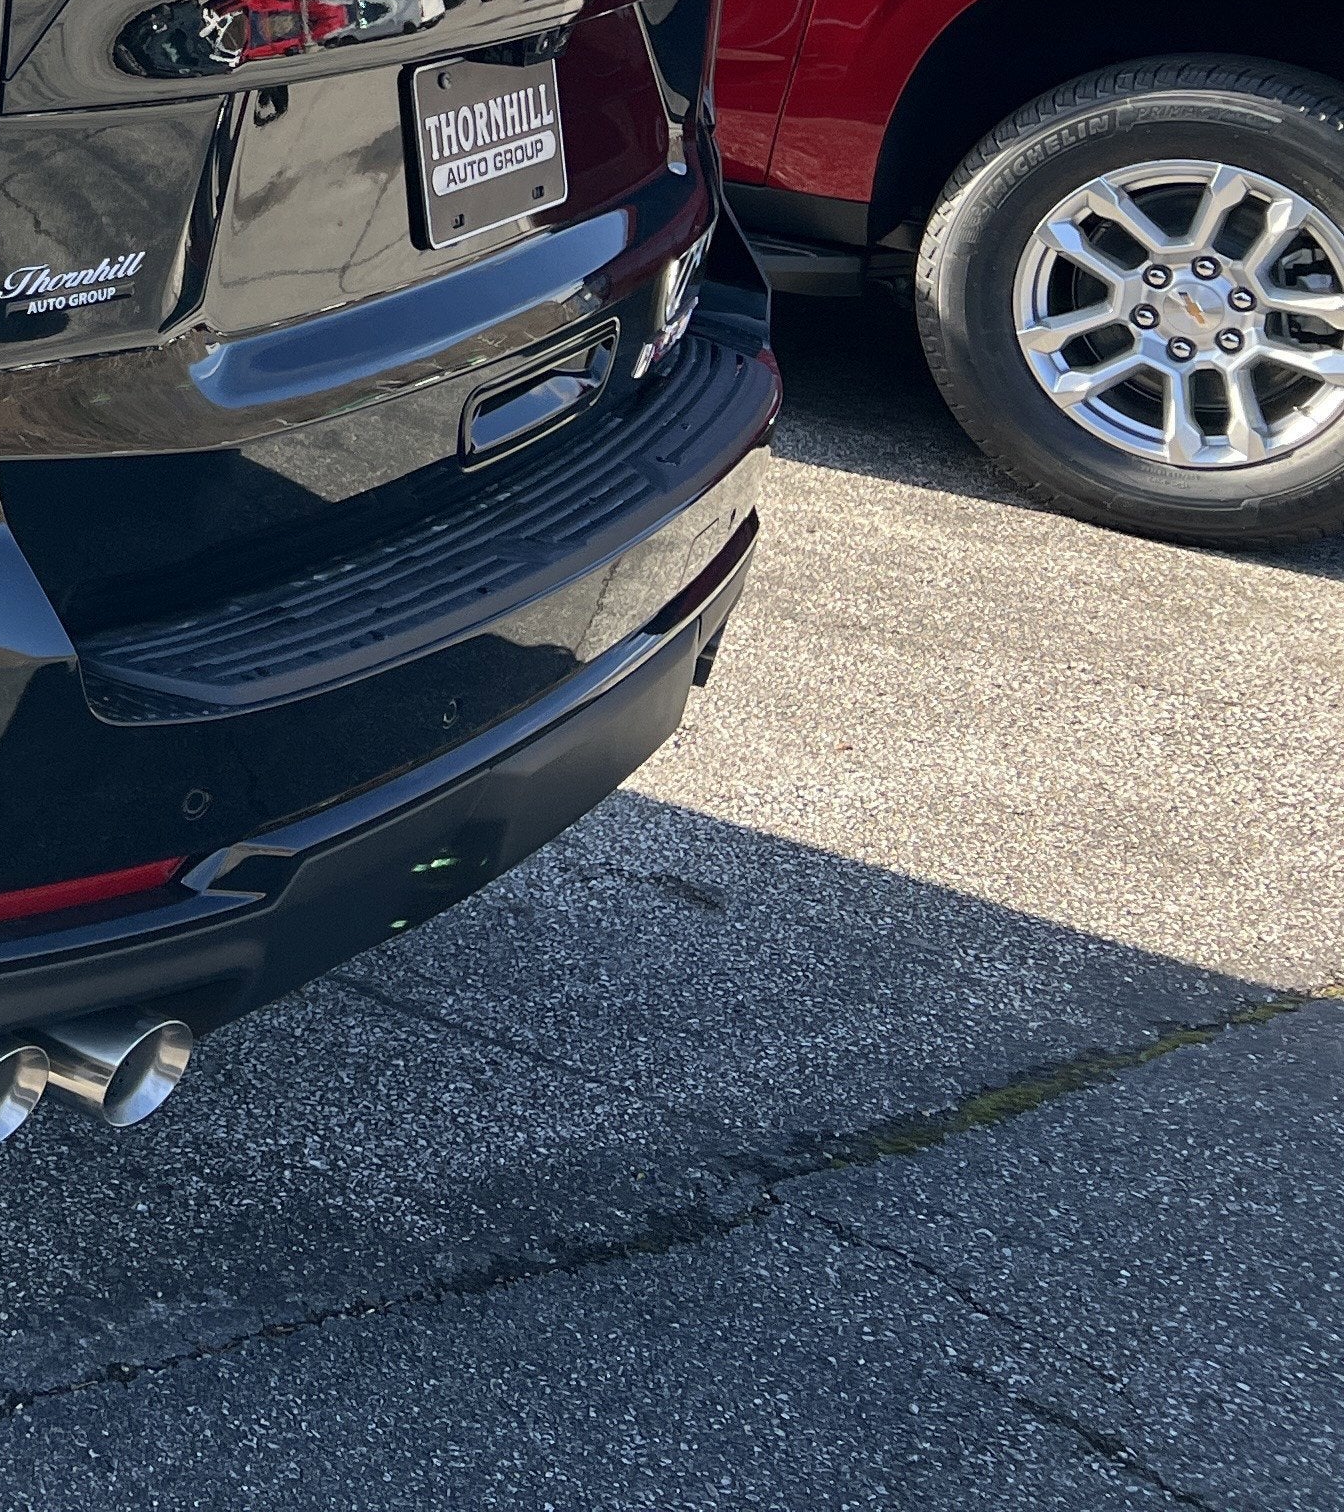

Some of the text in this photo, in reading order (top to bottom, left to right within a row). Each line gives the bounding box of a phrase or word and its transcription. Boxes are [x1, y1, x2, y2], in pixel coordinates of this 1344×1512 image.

[424, 83, 555, 162] THORNHILL
[446, 138, 545, 189] AUTO GROUP
[986, 114, 1110, 206] MICHELIN
[26, 287, 116, 315] AUTO GROUP
